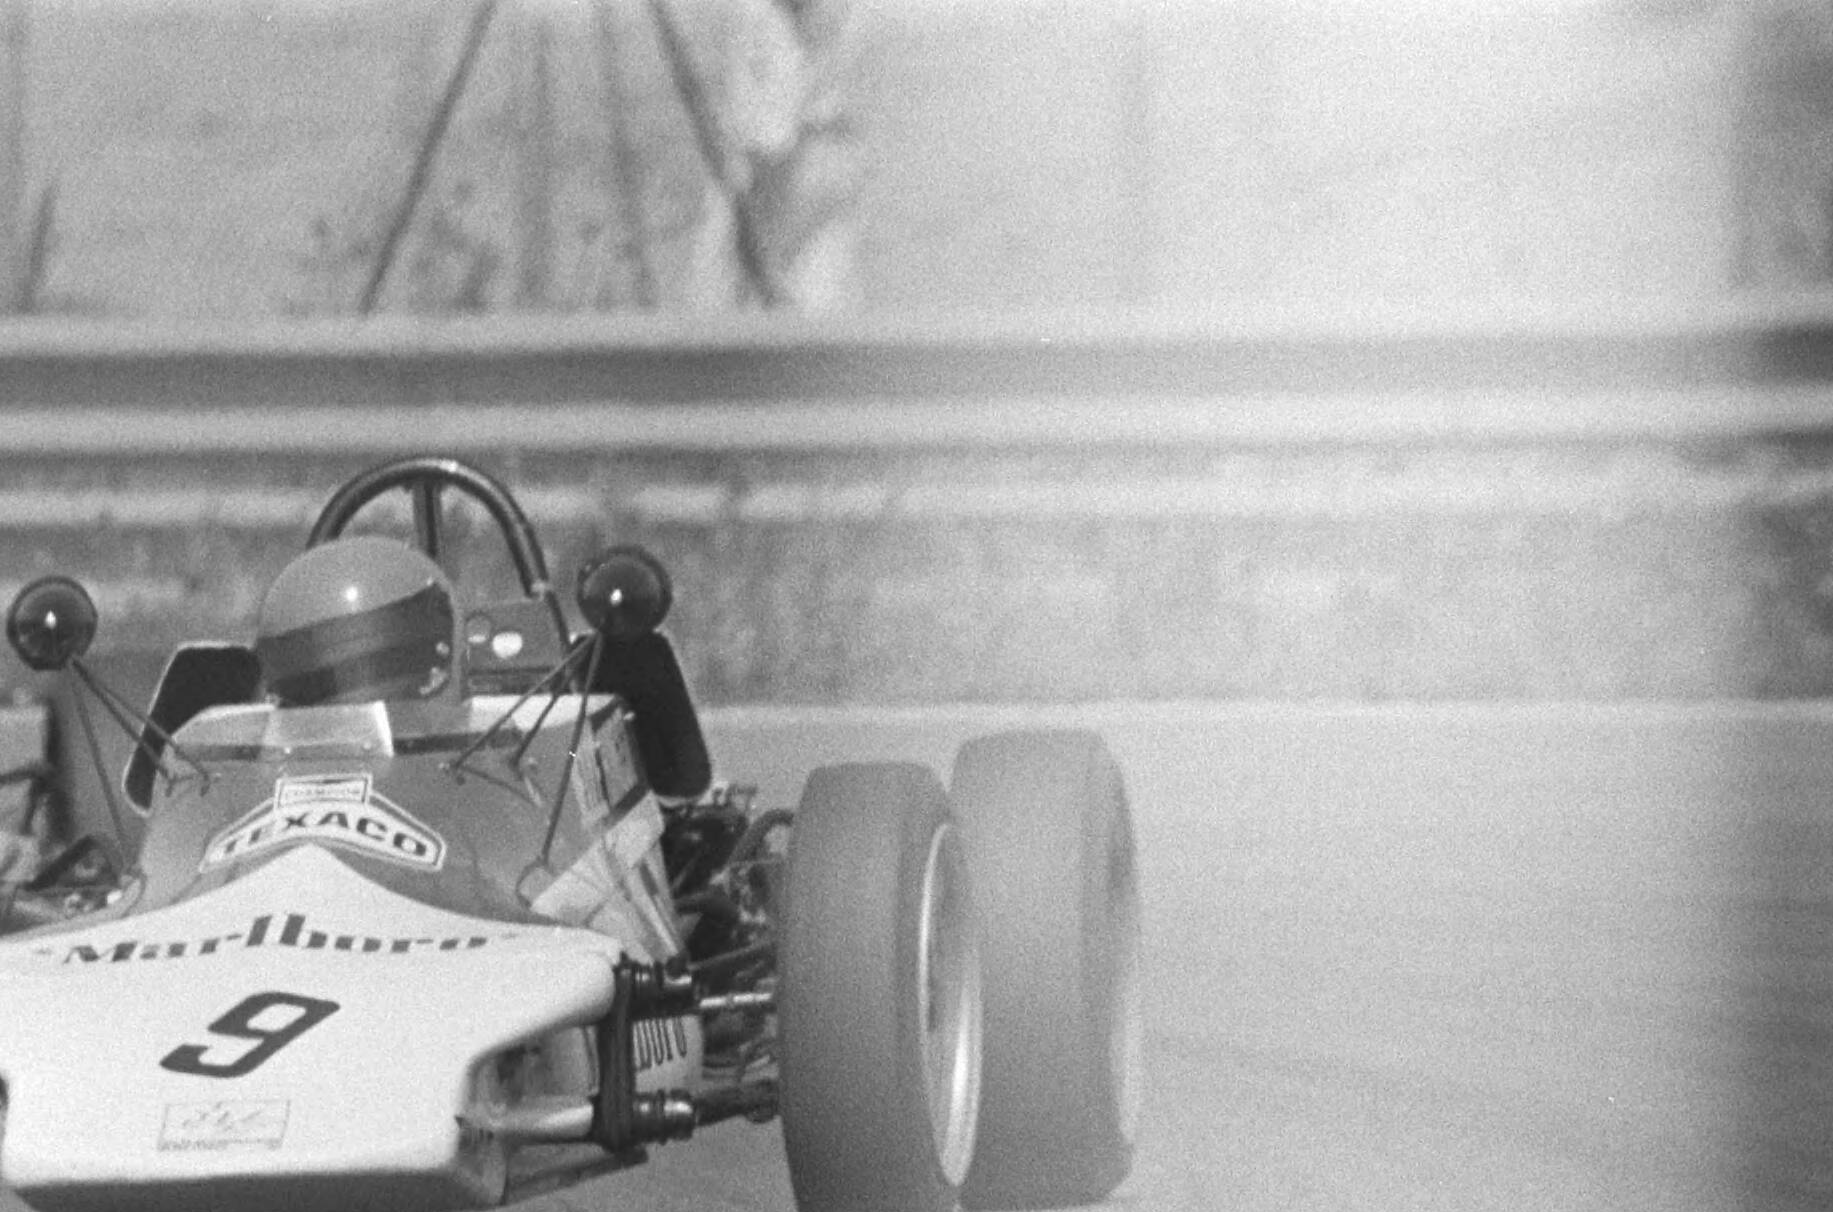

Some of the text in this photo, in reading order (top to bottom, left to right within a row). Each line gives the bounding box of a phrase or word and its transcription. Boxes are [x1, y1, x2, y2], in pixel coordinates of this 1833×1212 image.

[218, 811, 428, 858] TEXACO
[63, 913, 488, 964] Marlboro
[159, 991, 341, 1079] 9
